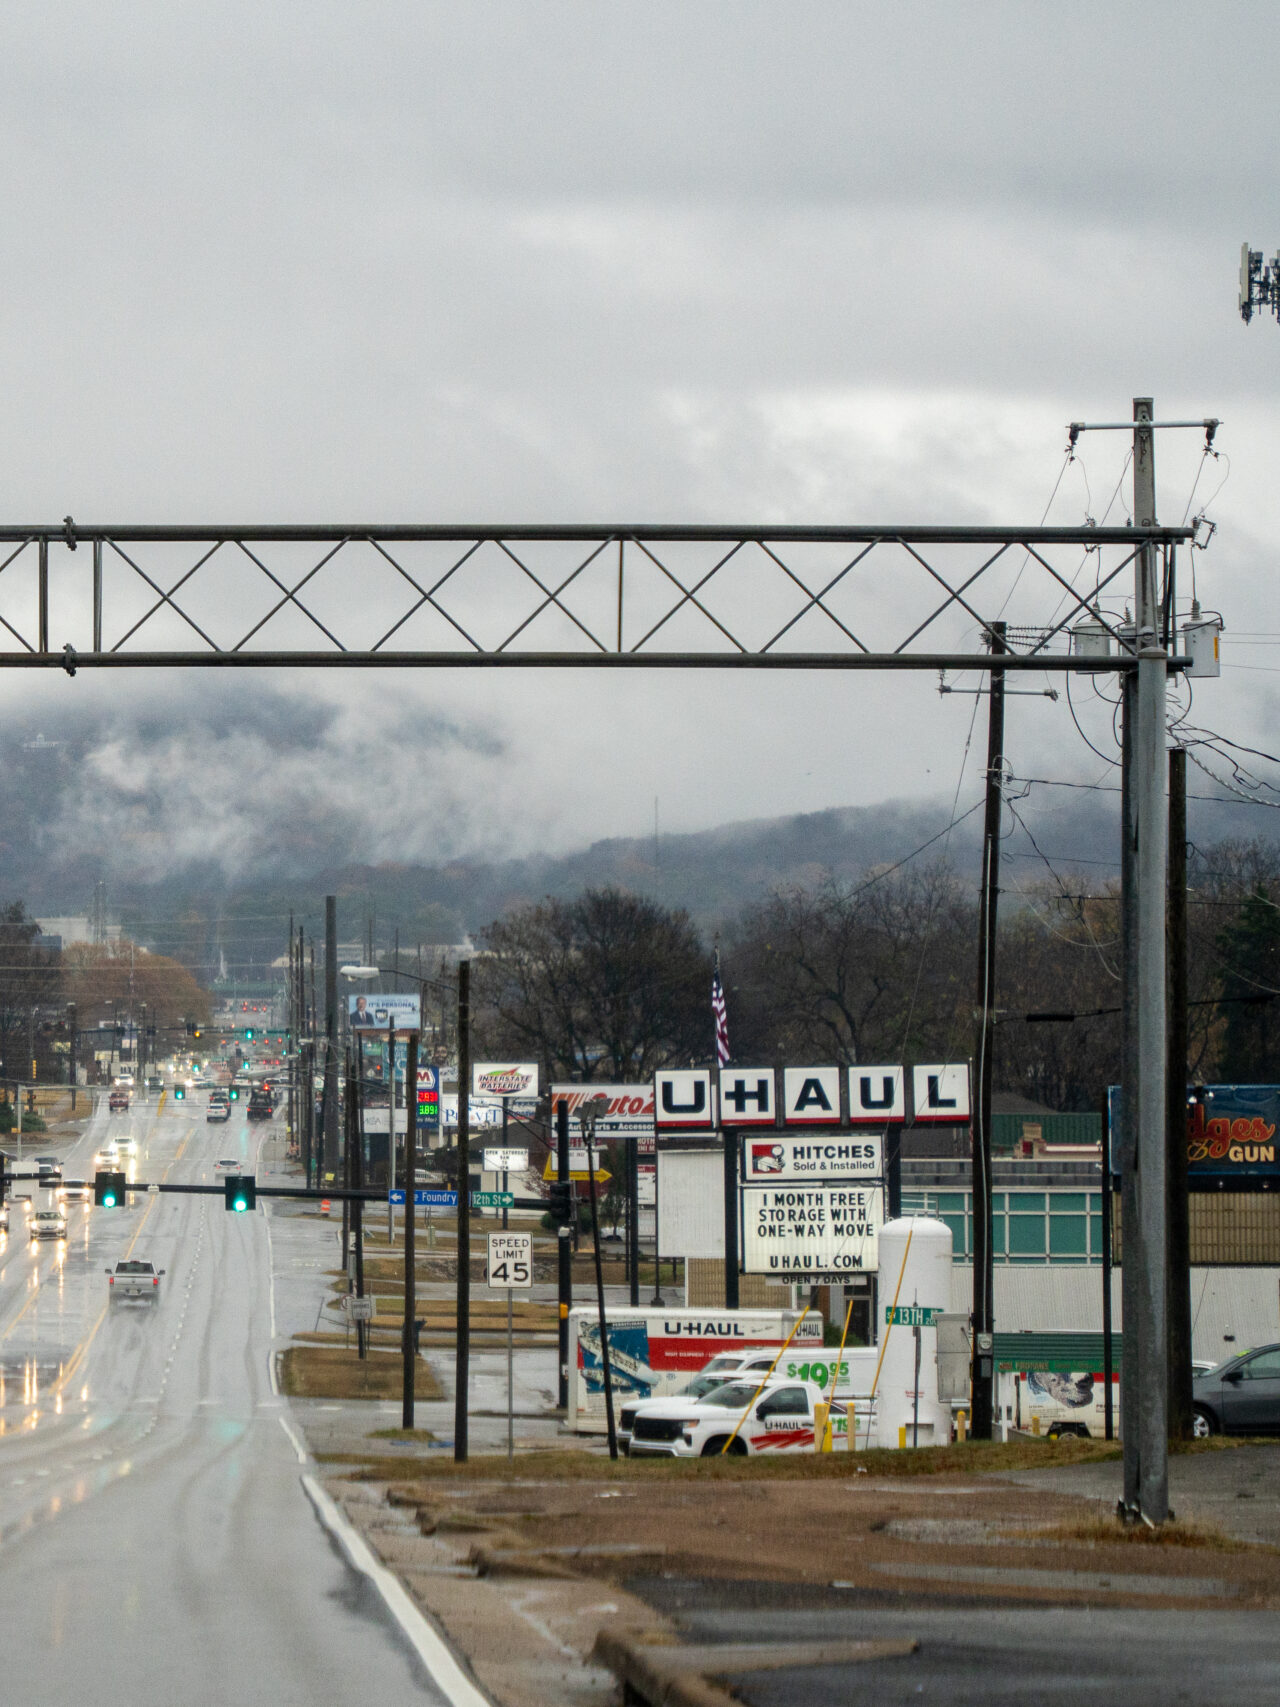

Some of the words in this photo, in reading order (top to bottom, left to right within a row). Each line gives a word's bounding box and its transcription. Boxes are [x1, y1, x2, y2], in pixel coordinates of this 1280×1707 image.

[479, 1075, 531, 1083] INTERSTATE
[480, 1082, 527, 1090] BATTERIES
[793, 1144, 875, 1160] HITCHES
[1228, 1145, 1275, 1163] GUN
[793, 1161, 817, 1171] Sold
[819, 1160, 827, 1170] &
[830, 1160, 875, 1171] Installed
[422, 1191, 457, 1205] Foundry
[492, 1194, 502, 1205] St
[775, 1193, 823, 1206] MONTH
[830, 1192, 865, 1206] FREE
[759, 1208, 826, 1222] STORAGE
[831, 1208, 867, 1221] WITH
[757, 1224, 826, 1238] ONE-WAY
[834, 1224, 874, 1237] MOVE
[491, 1238, 529, 1248] SPEED
[495, 1250, 524, 1259] LIMIT
[491, 1262, 529, 1282] 45
[782, 1275, 811, 1284] OPEN
[823, 1275, 850, 1284] DAYS
[899, 1308, 923, 1325] 13TH
